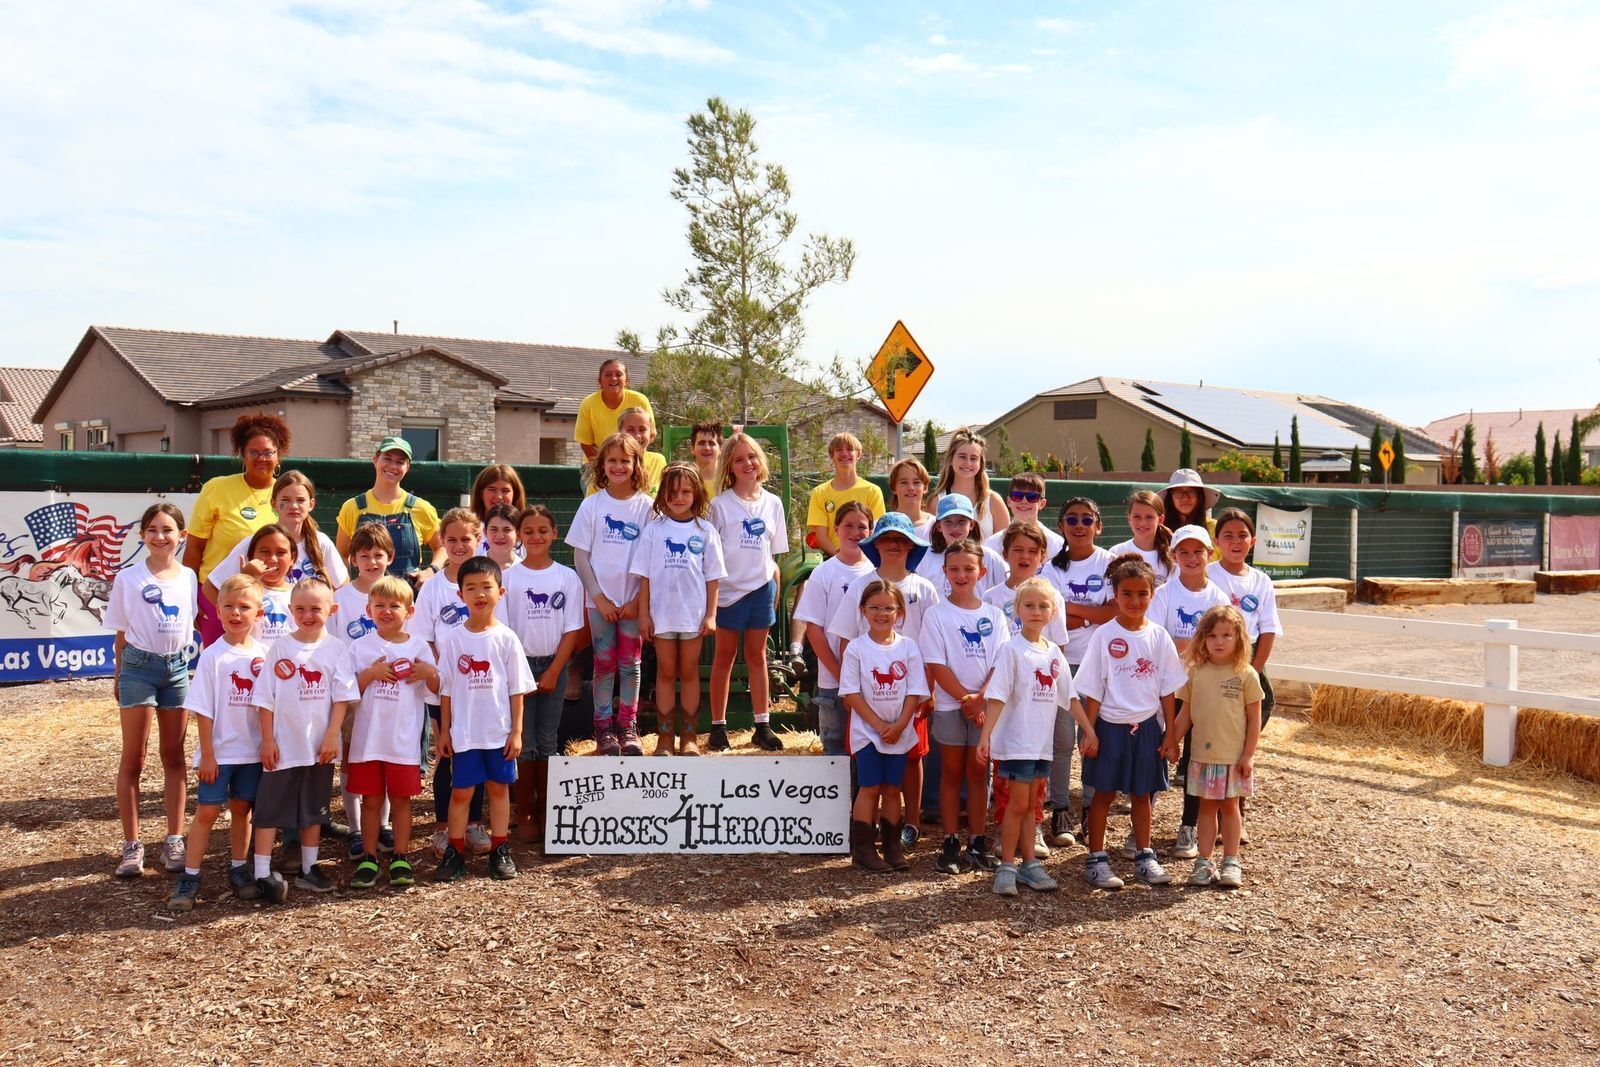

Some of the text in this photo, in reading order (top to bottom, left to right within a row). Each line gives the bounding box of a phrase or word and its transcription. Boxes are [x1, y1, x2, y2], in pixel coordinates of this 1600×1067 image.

[0, 649, 30, 671] as
[37, 644, 106, 672] Vegas
[560, 772, 687, 797] THE RANCH
[642, 789, 670, 799] 2006
[720, 778, 839, 805] Las Vegas
[574, 791, 605, 805] ESTD
